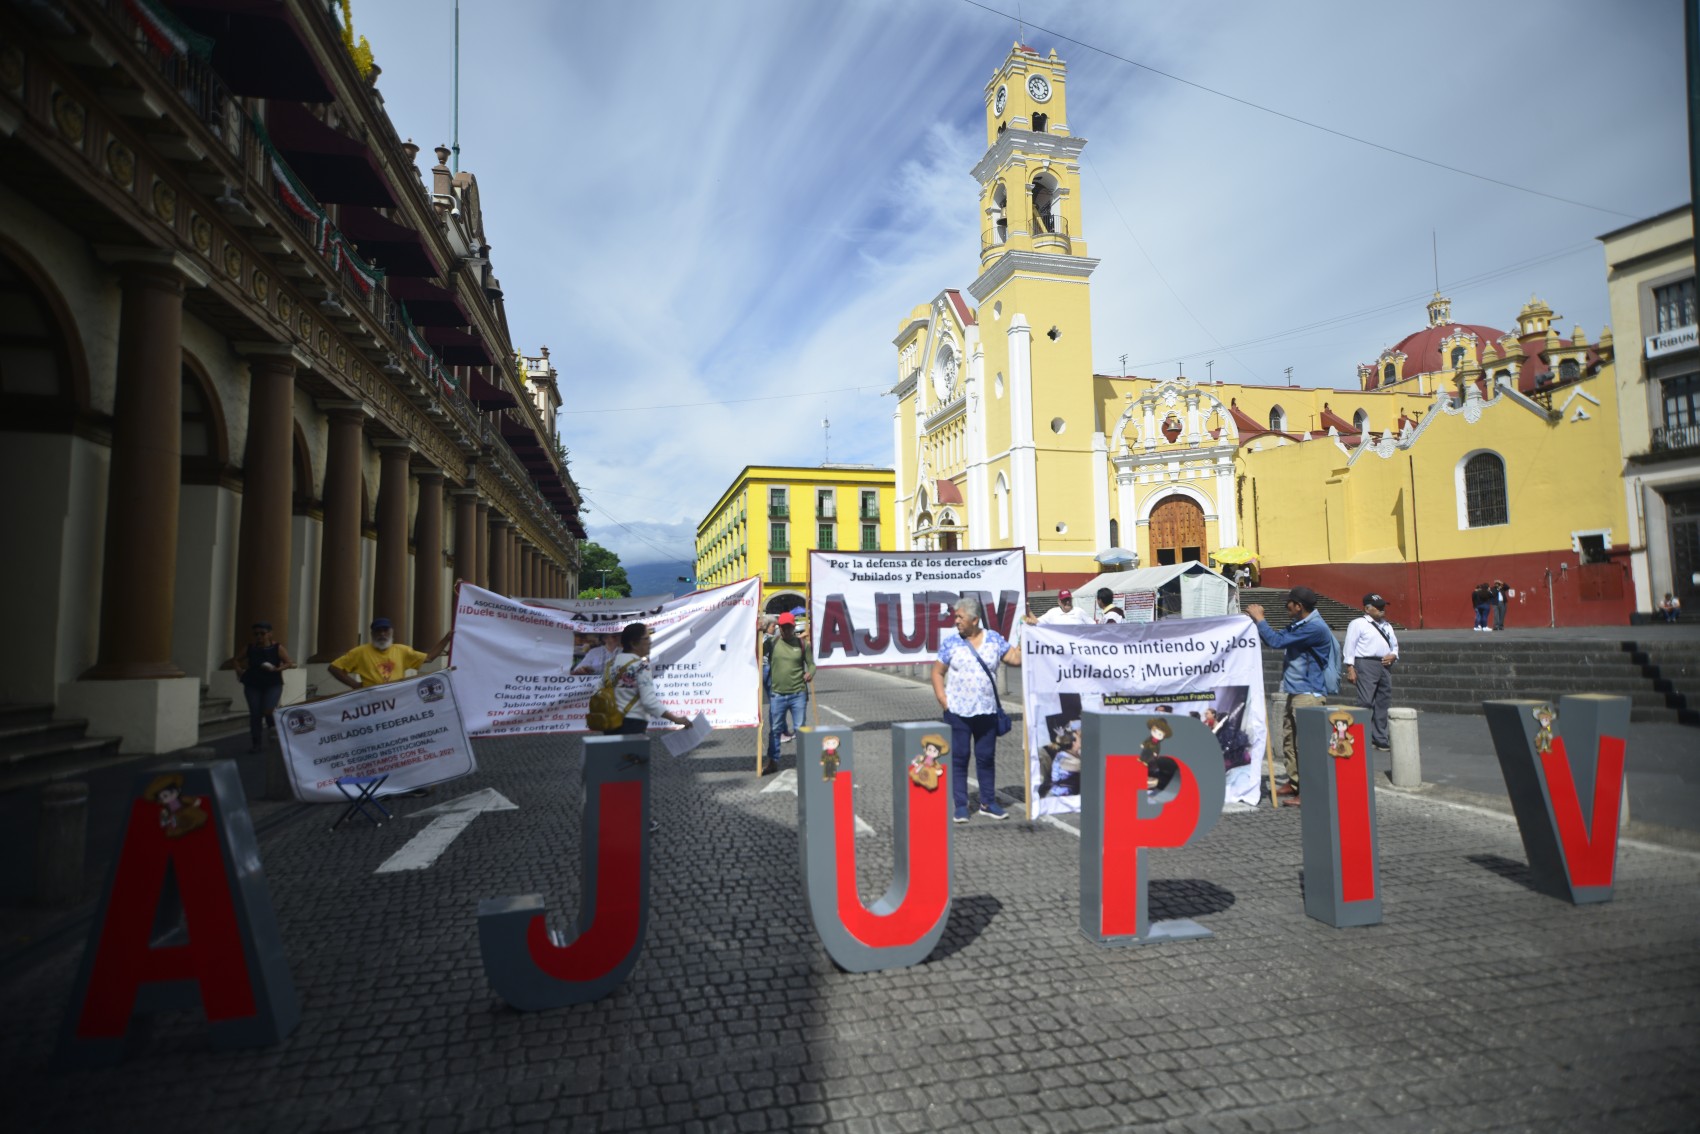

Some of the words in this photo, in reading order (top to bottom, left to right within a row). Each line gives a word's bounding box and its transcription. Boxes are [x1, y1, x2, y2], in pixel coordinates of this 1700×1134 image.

[1650, 332, 1698, 350] TRIBUN
[853, 558, 863, 568] la
[866, 558, 907, 568] defensa
[911, 558, 923, 567] de
[926, 558, 941, 567] los
[945, 557, 992, 567] derechos
[995, 556, 1008, 566] de
[850, 571, 903, 582] Jubilados
[906, 573, 912, 583] y
[474, 600, 517, 613] ASOCIACION
[497, 611, 508, 619] su
[510, 612, 555, 628] indolente
[556, 621, 574, 631] risa
[818, 590, 1020, 659] AJUPV
[1026, 640, 1065, 655] Lima
[1070, 642, 1119, 656] Franco
[1124, 637, 1206, 655] mintiendo
[515, 674, 539, 683] QUE
[543, 675, 575, 683] TODO
[668, 671, 714, 681] Bardahuil,
[1057, 664, 1136, 683] jubilados?
[1141, 660, 1226, 681] ¡Muriendo!
[664, 682, 690, 690] sobre
[1189, 693, 1215, 701] Franco
[341, 697, 397, 723] AJUPIV
[507, 708, 544, 716] POLIZA
[684, 698, 725, 706] VIGENTE
[492, 719, 523, 727] Desde
[552, 713, 562, 721] de
[694, 708, 718, 716] 2024
[524, 722, 571, 731] contrató?
[318, 724, 374, 746] JUBILADOS
[375, 709, 435, 731] FEDERALES
[313, 750, 350, 766] EXIGIMOS
[410, 726, 450, 743] INMEDIATA
[330, 761, 347, 769] DEL
[347, 752, 379, 765] SEGURO
[380, 737, 437, 757] INSTITUCIONAL
[343, 764, 356, 775] NO
[355, 754, 399, 771] CONTAMOS
[400, 749, 418, 759] CON
[417, 747, 428, 755] EL
[378, 756, 423, 772] NOVIEMBRE
[423, 753, 439, 761] DEL
